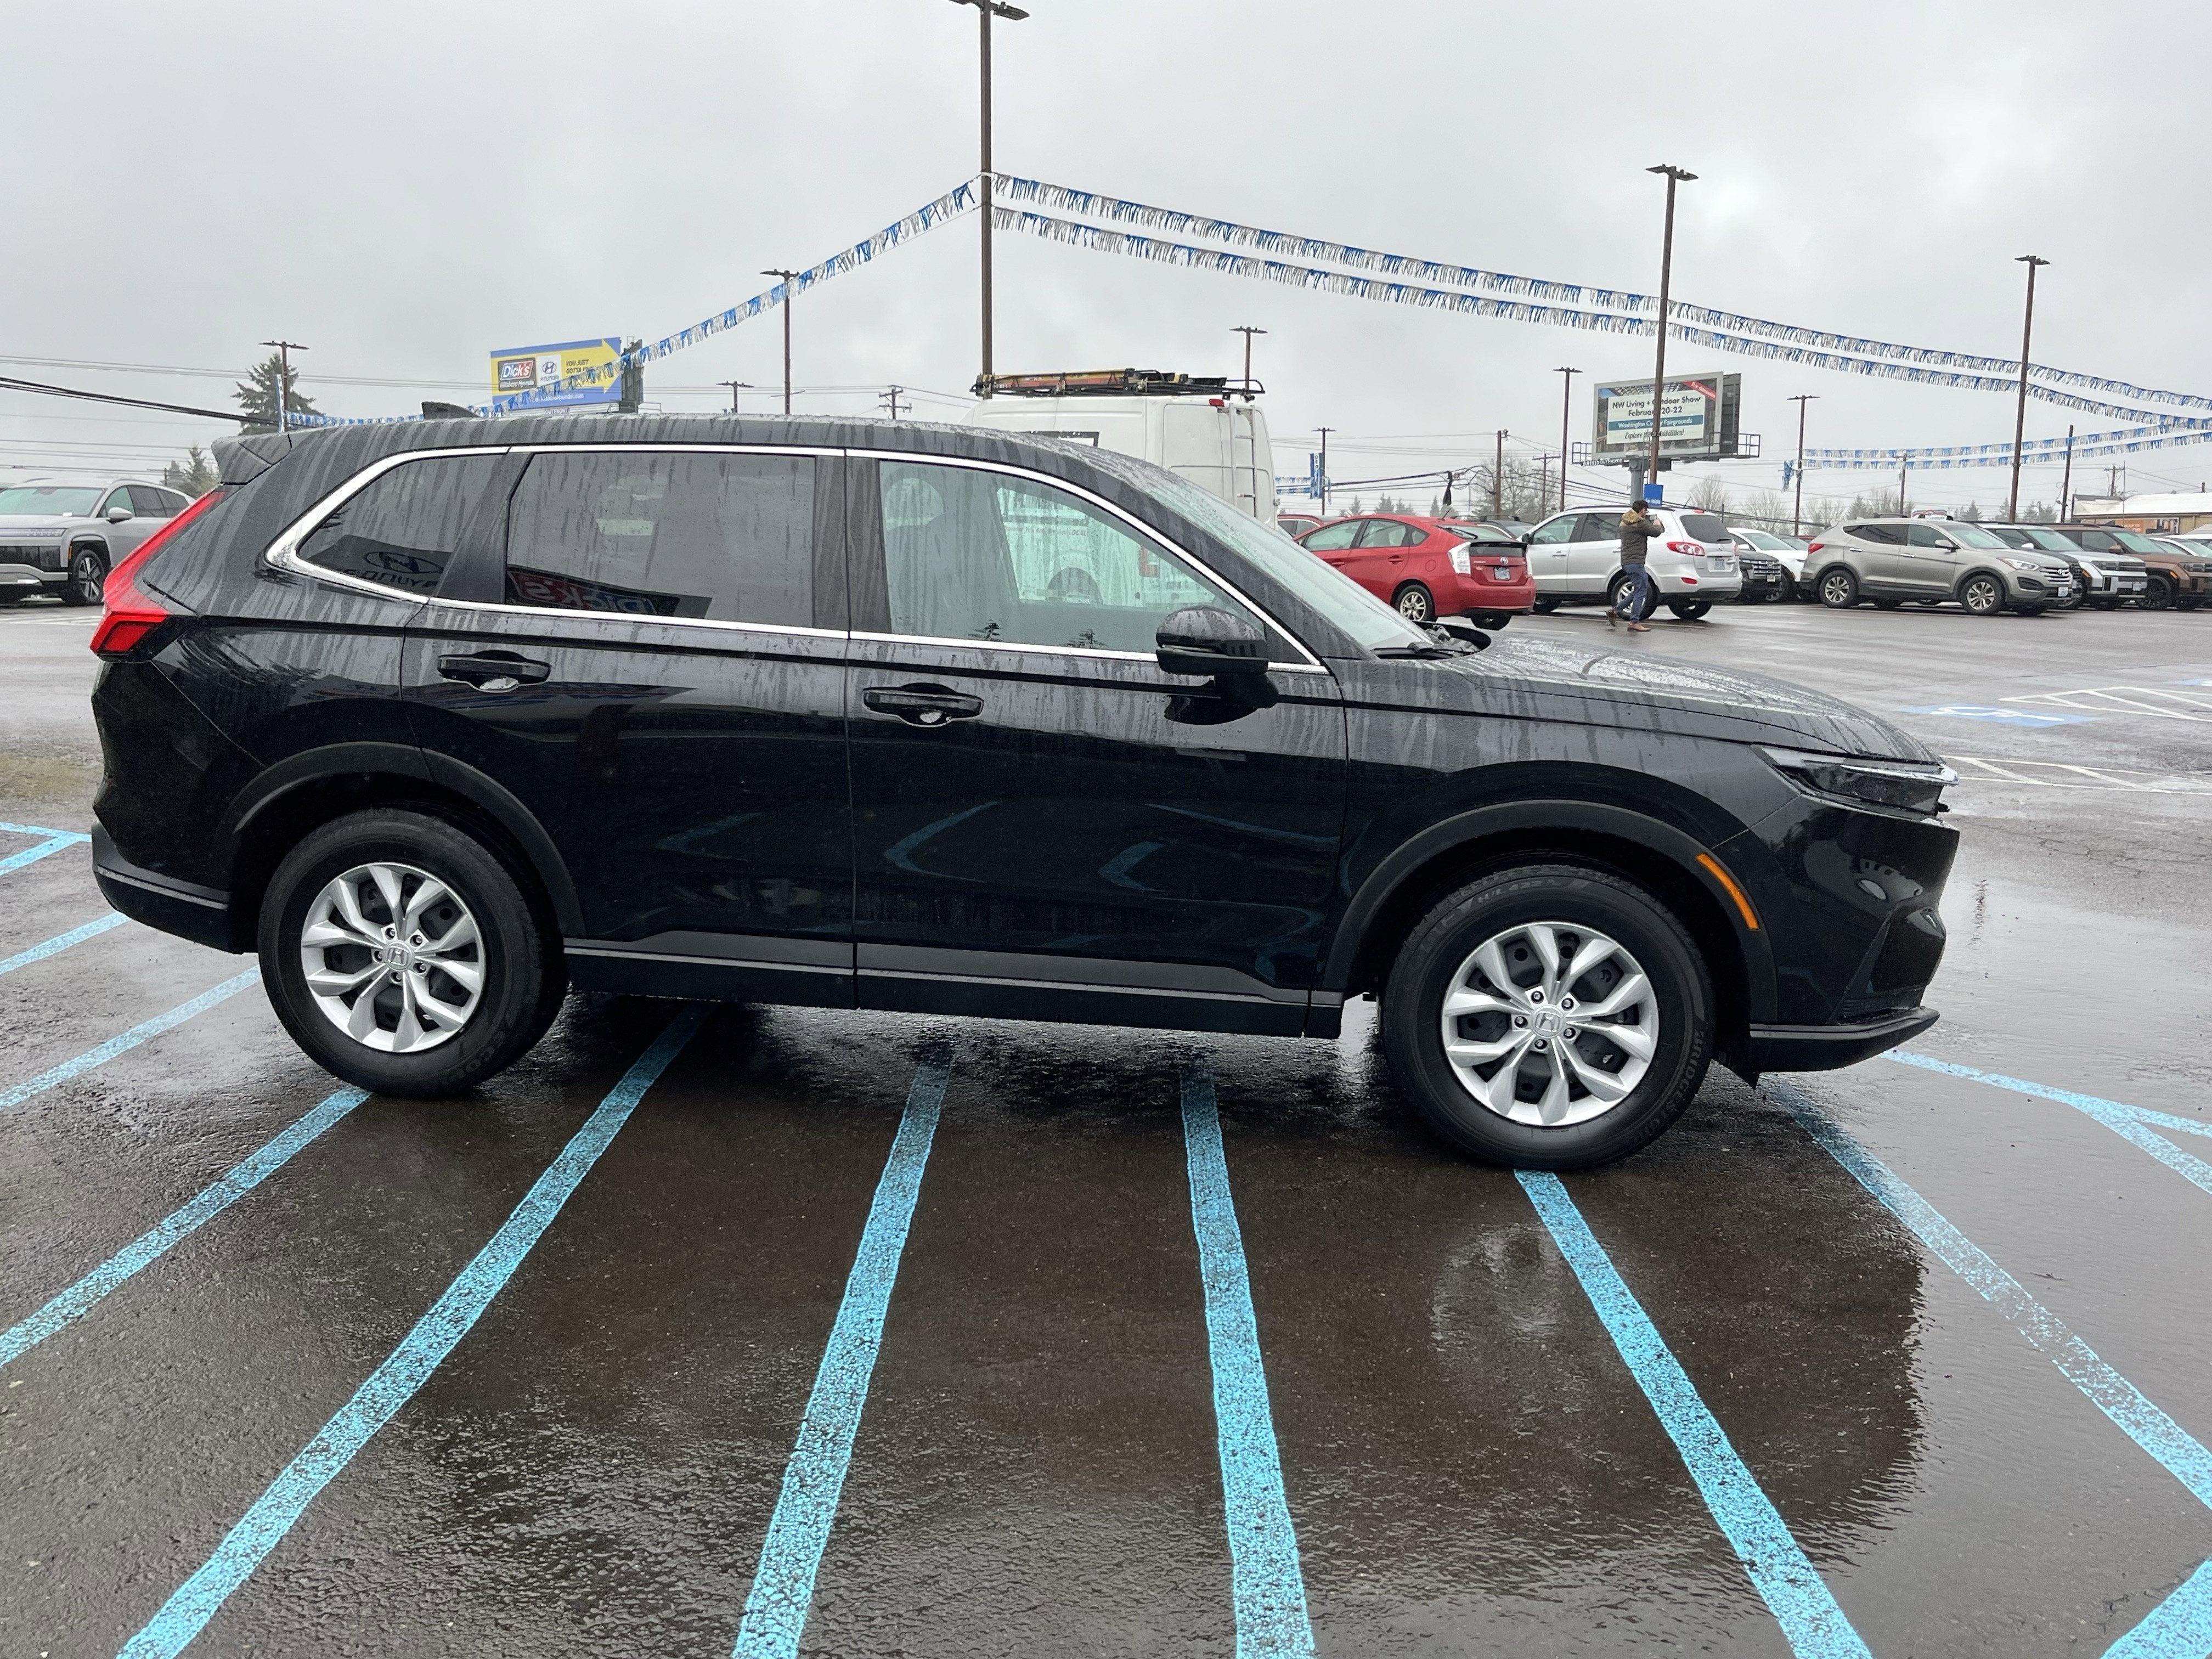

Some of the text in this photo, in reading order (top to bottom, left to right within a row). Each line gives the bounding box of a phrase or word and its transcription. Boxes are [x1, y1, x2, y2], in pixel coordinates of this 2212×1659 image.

[503, 363, 531, 377] Dick's
[1626, 399, 1645, 408] Living
[1652, 397, 1680, 406] tdoor
[1681, 396, 1701, 404] Show
[1661, 406, 1683, 414] 20-22
[1664, 417, 1692, 426] Fairgrounds
[1624, 432, 1643, 441] Explore
[1630, 1029, 1705, 1144] BRIDGESTON
